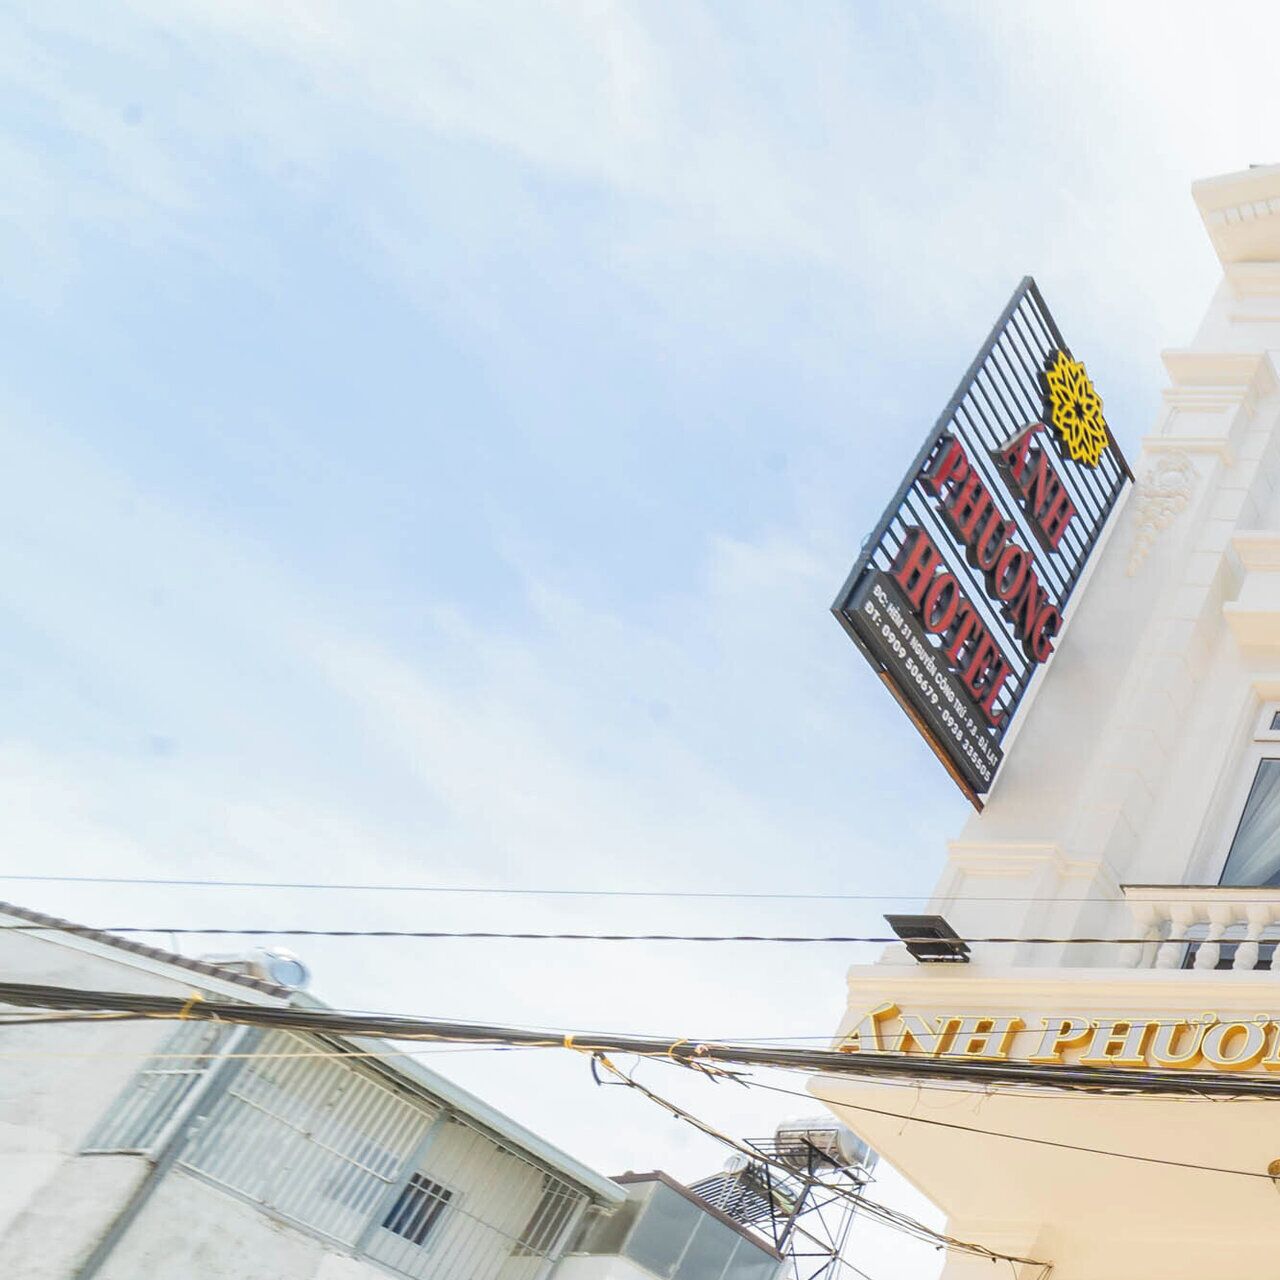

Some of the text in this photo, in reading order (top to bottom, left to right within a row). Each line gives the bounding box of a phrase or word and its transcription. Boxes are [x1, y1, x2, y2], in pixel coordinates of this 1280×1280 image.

[882, 624, 907, 658] 0909
[905, 657, 939, 704] 506679
[942, 709, 963, 741] 0938
[962, 738, 991, 782] 335505
[893, 526, 1013, 726] HOTEL
